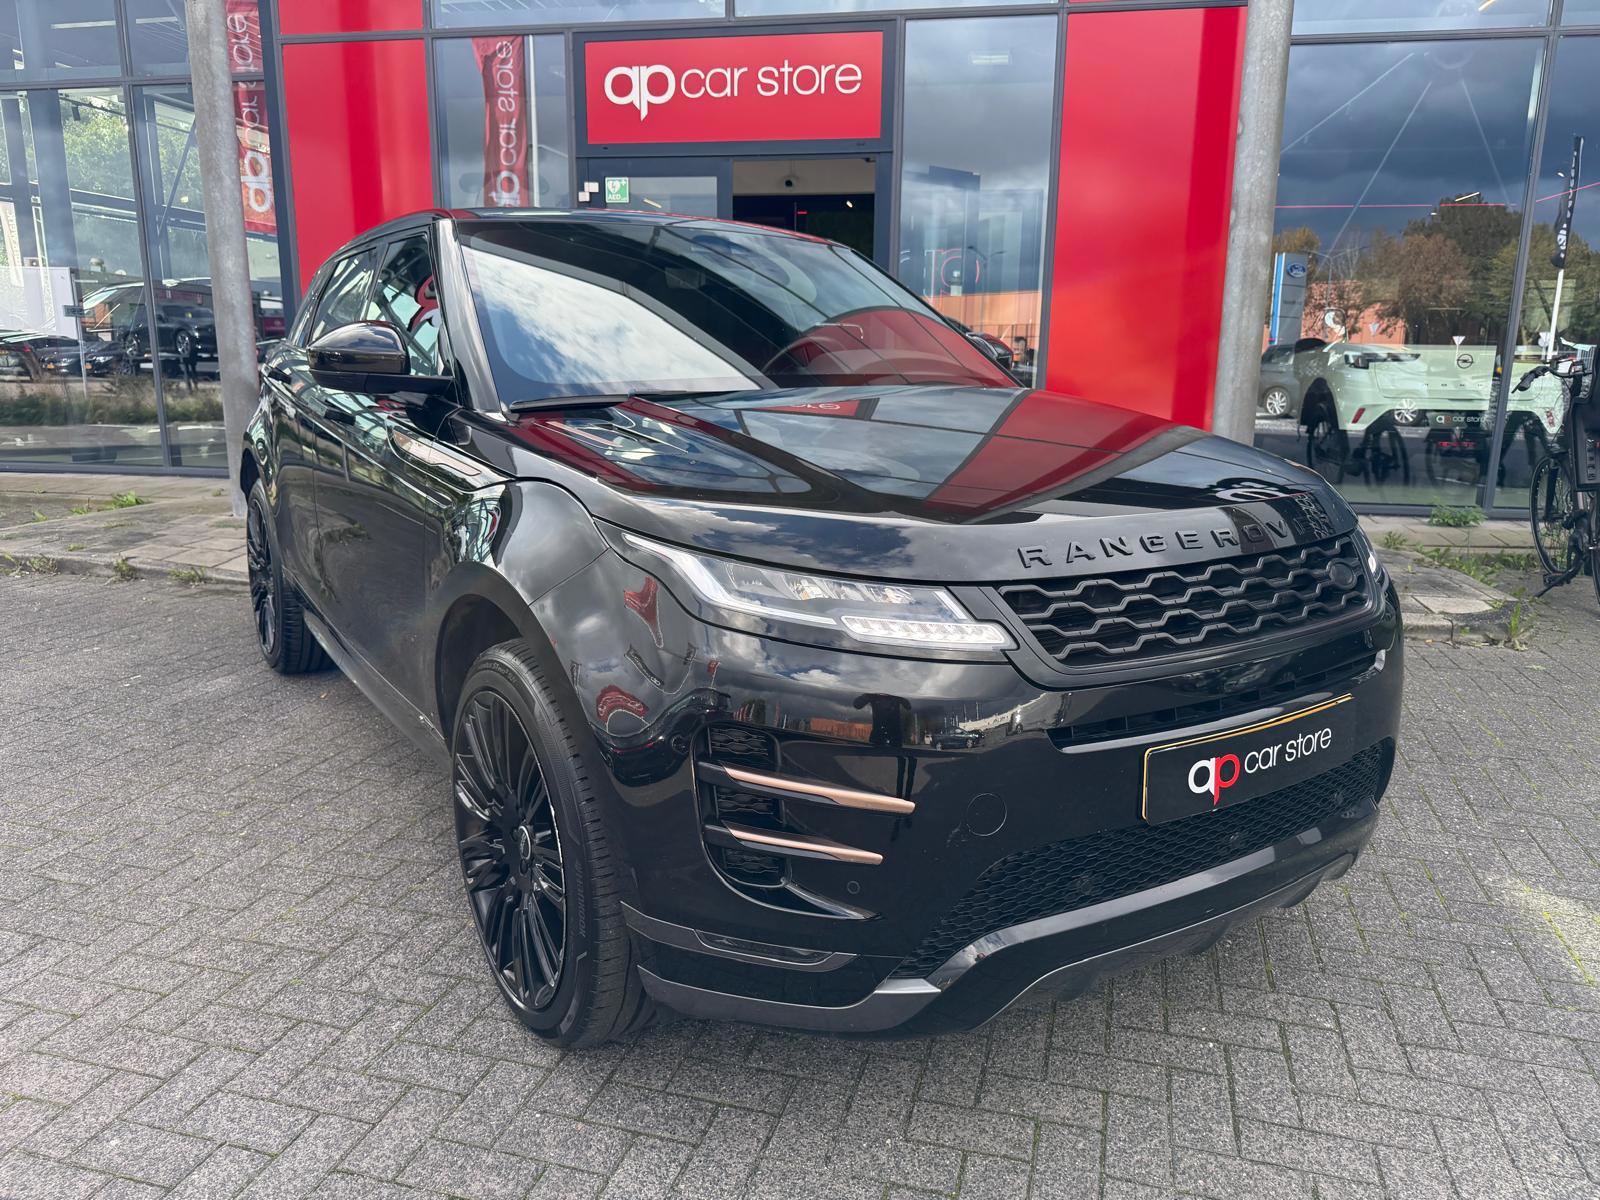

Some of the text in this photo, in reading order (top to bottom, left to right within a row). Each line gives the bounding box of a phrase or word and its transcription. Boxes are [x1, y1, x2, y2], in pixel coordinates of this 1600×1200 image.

[603, 59, 862, 122] ap car store
[1188, 727, 1332, 806] ap car store
